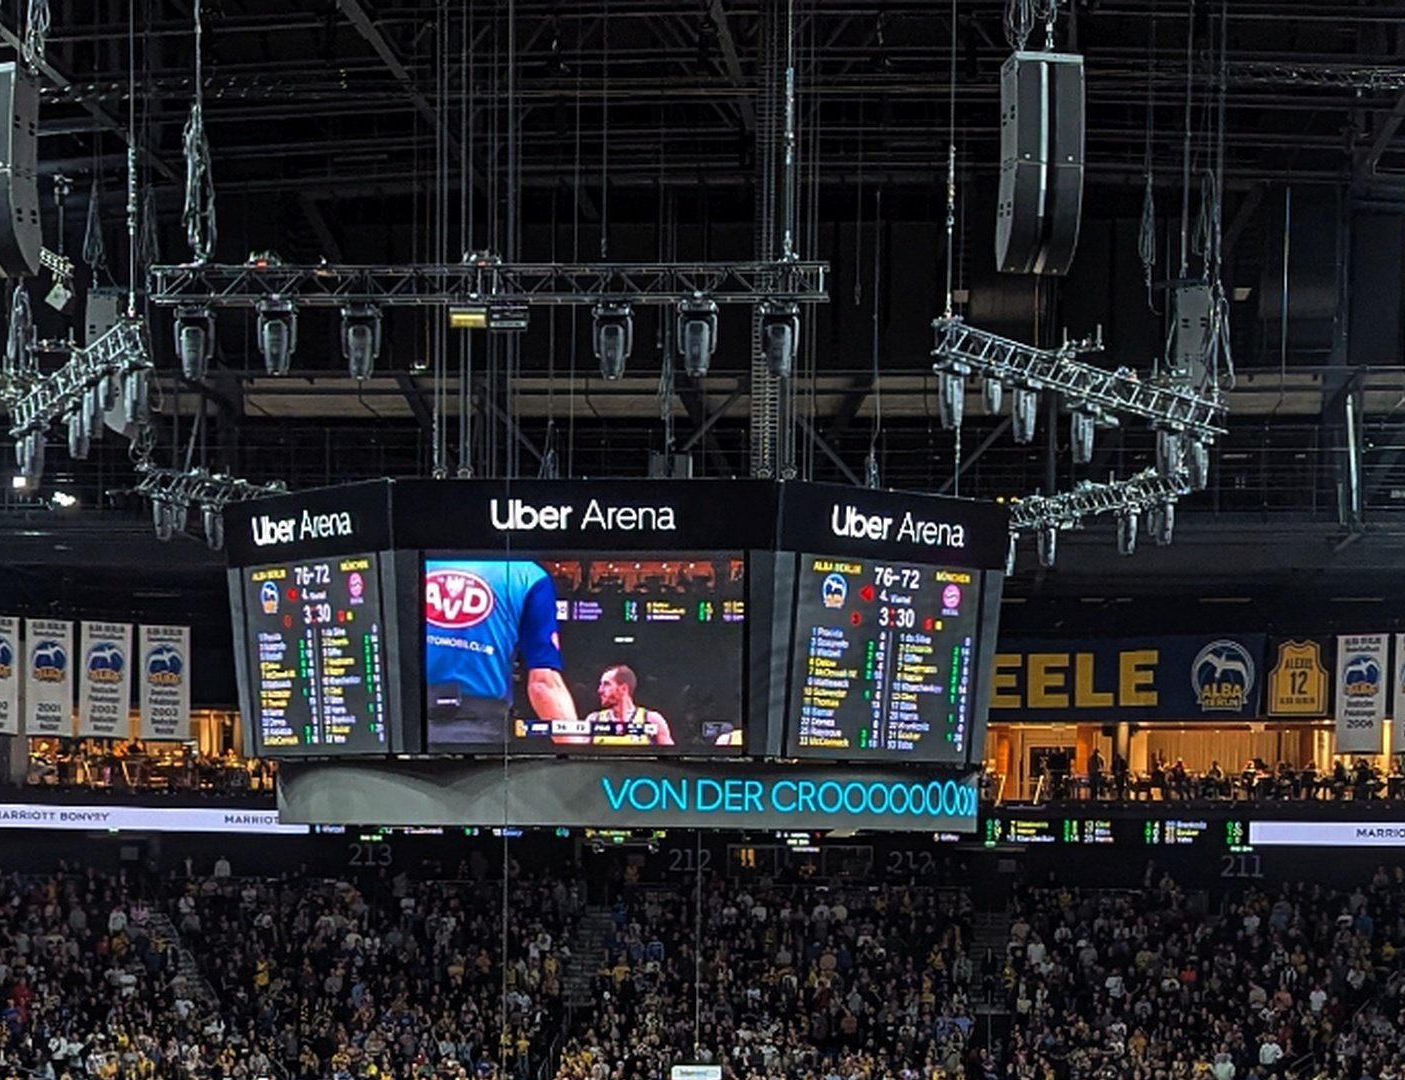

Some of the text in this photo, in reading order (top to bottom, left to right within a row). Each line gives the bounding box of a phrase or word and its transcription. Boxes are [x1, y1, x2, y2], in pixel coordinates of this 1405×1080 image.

[489, 498, 677, 530] Uber Arena
[830, 503, 965, 548] Uber Arena
[251, 509, 353, 546] Uber Arena
[294, 563, 331, 586] 76-72
[813, 560, 833, 572] ALBA
[874, 565, 921, 590] 76-72
[302, 604, 332, 624] 3:30
[878, 606, 916, 629] 3:30
[1201, 683, 1243, 698] ALBA
[1289, 671, 1308, 696] 12
[37, 703, 62, 713] 2001
[90, 704, 118, 715] 2002
[601, 777, 689, 811] VON
[696, 780, 765, 813] DER
[348, 843, 393, 867] 213
[669, 848, 711, 869] 212
[1220, 854, 1264, 878] 211
